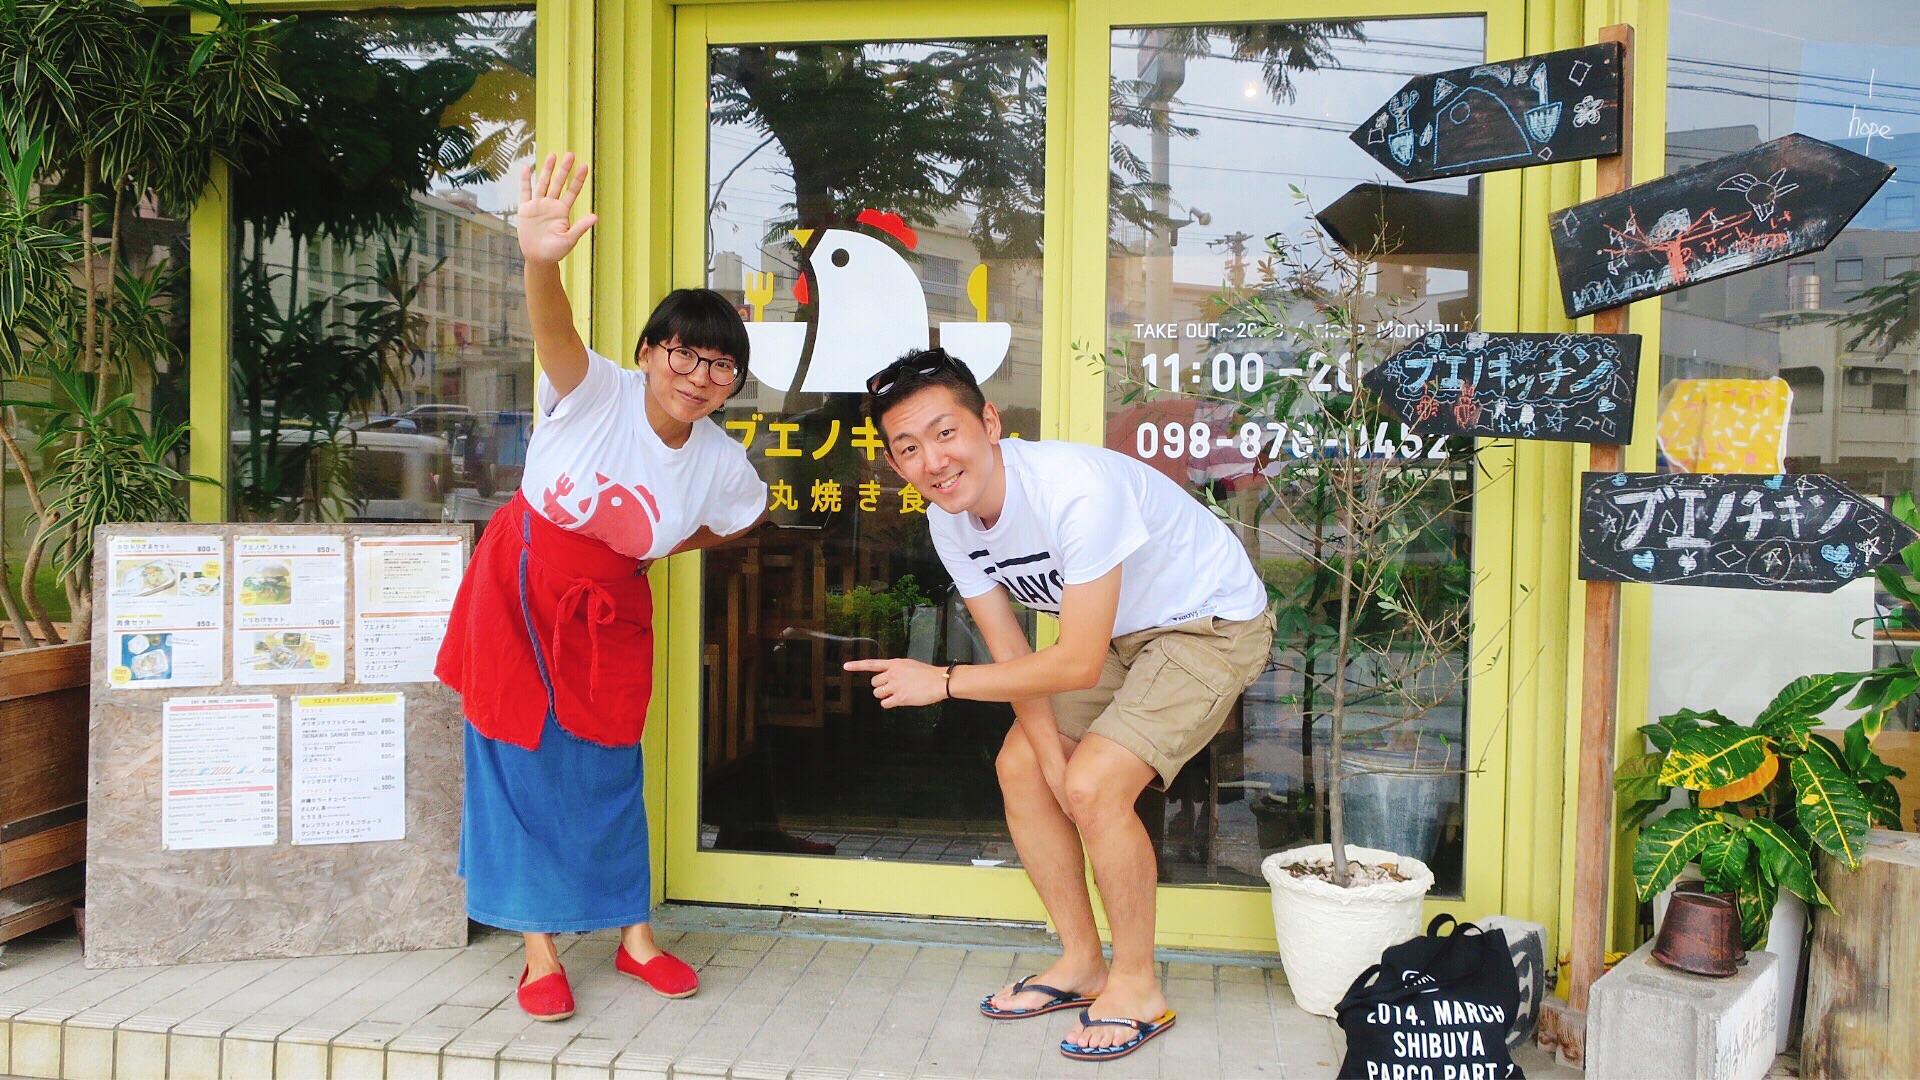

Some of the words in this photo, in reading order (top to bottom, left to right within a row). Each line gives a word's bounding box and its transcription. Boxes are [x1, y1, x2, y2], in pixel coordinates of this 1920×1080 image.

[1848, 104, 1895, 156] hope
[1134, 323, 1178, 339] TAKE
[1404, 344, 1615, 400] ブエノキッチン
[1613, 484, 1859, 550] ブエノチキン
[1434, 1000, 1505, 1026] MARCH
[1393, 1030, 1485, 1059] SHIBUYA
[1366, 1060, 1434, 1080] PARCO
[1443, 1062, 1497, 1080] PART
